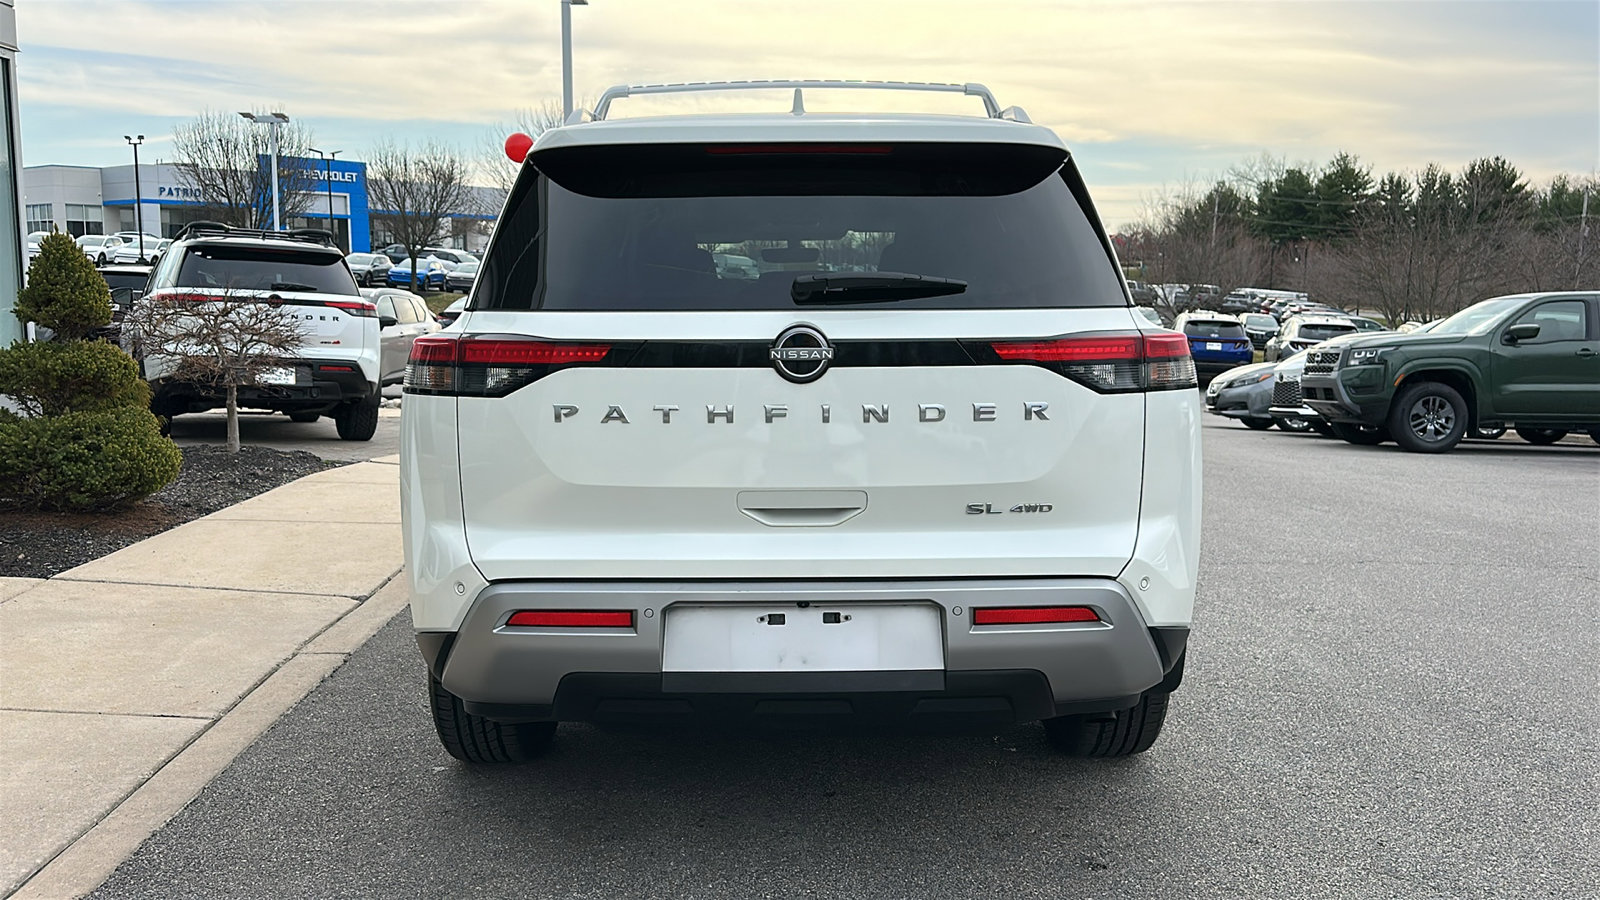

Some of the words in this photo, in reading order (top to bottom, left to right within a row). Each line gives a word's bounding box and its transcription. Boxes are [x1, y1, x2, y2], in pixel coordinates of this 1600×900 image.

[158, 186, 208, 199] PATRIO
[771, 350, 832, 359] NISSAN
[552, 401, 1051, 424] PATHFINDER
[966, 502, 1003, 515] SL
[1009, 503, 1053, 513] 4WD
